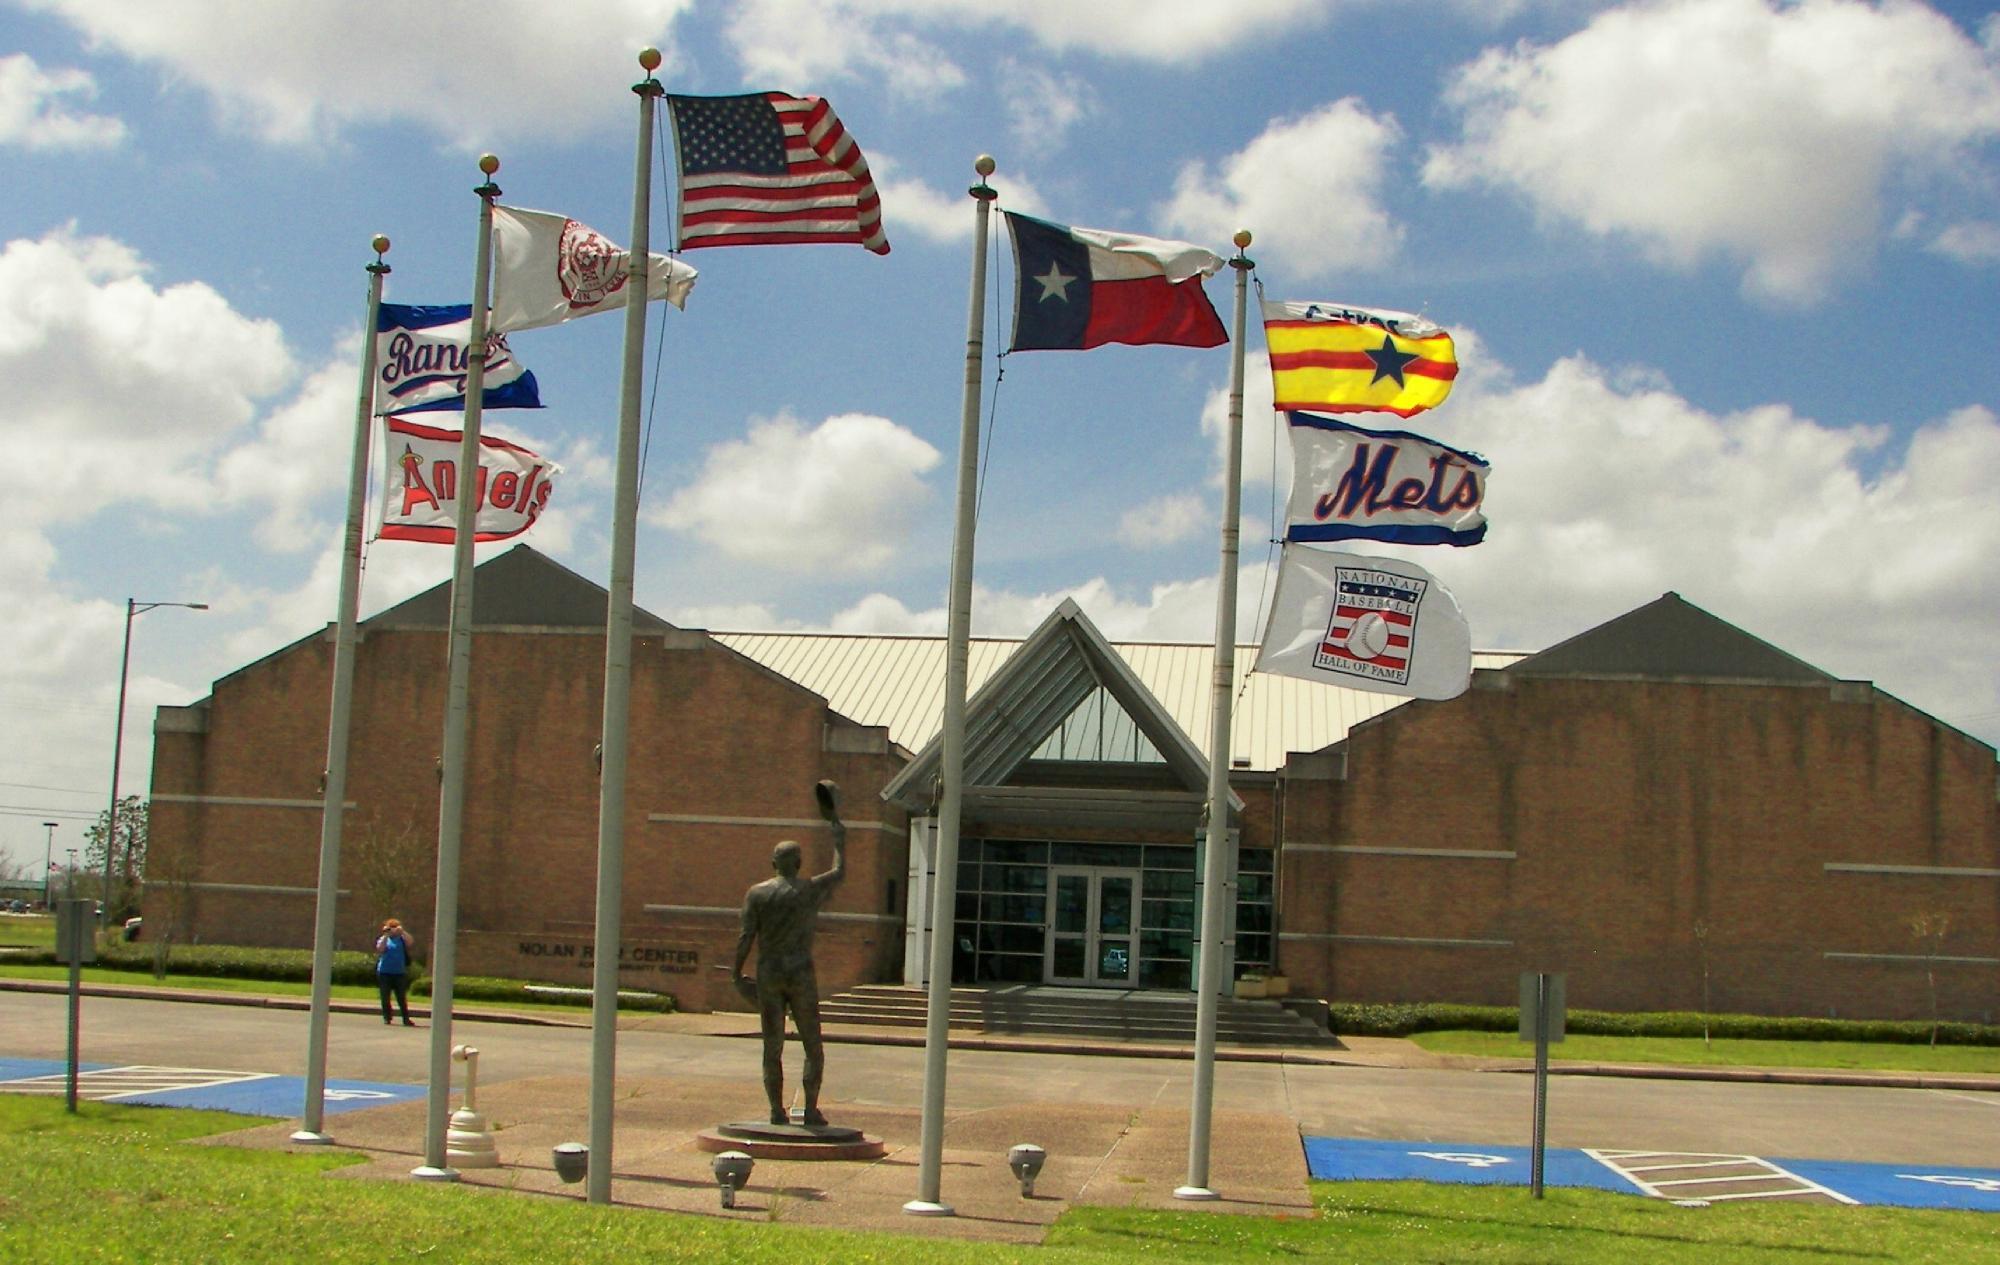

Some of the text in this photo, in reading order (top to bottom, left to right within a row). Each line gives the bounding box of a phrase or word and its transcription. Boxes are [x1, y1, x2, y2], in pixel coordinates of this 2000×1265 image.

[1314, 443, 1481, 520] Mets
[1340, 571, 1421, 593] NATIONAL
[1338, 593, 1413, 615] BASEBALL
[1318, 654, 1404, 681] HALL OF FAME
[519, 942, 574, 957] NOLAN
[632, 948, 698, 964] CENTER
